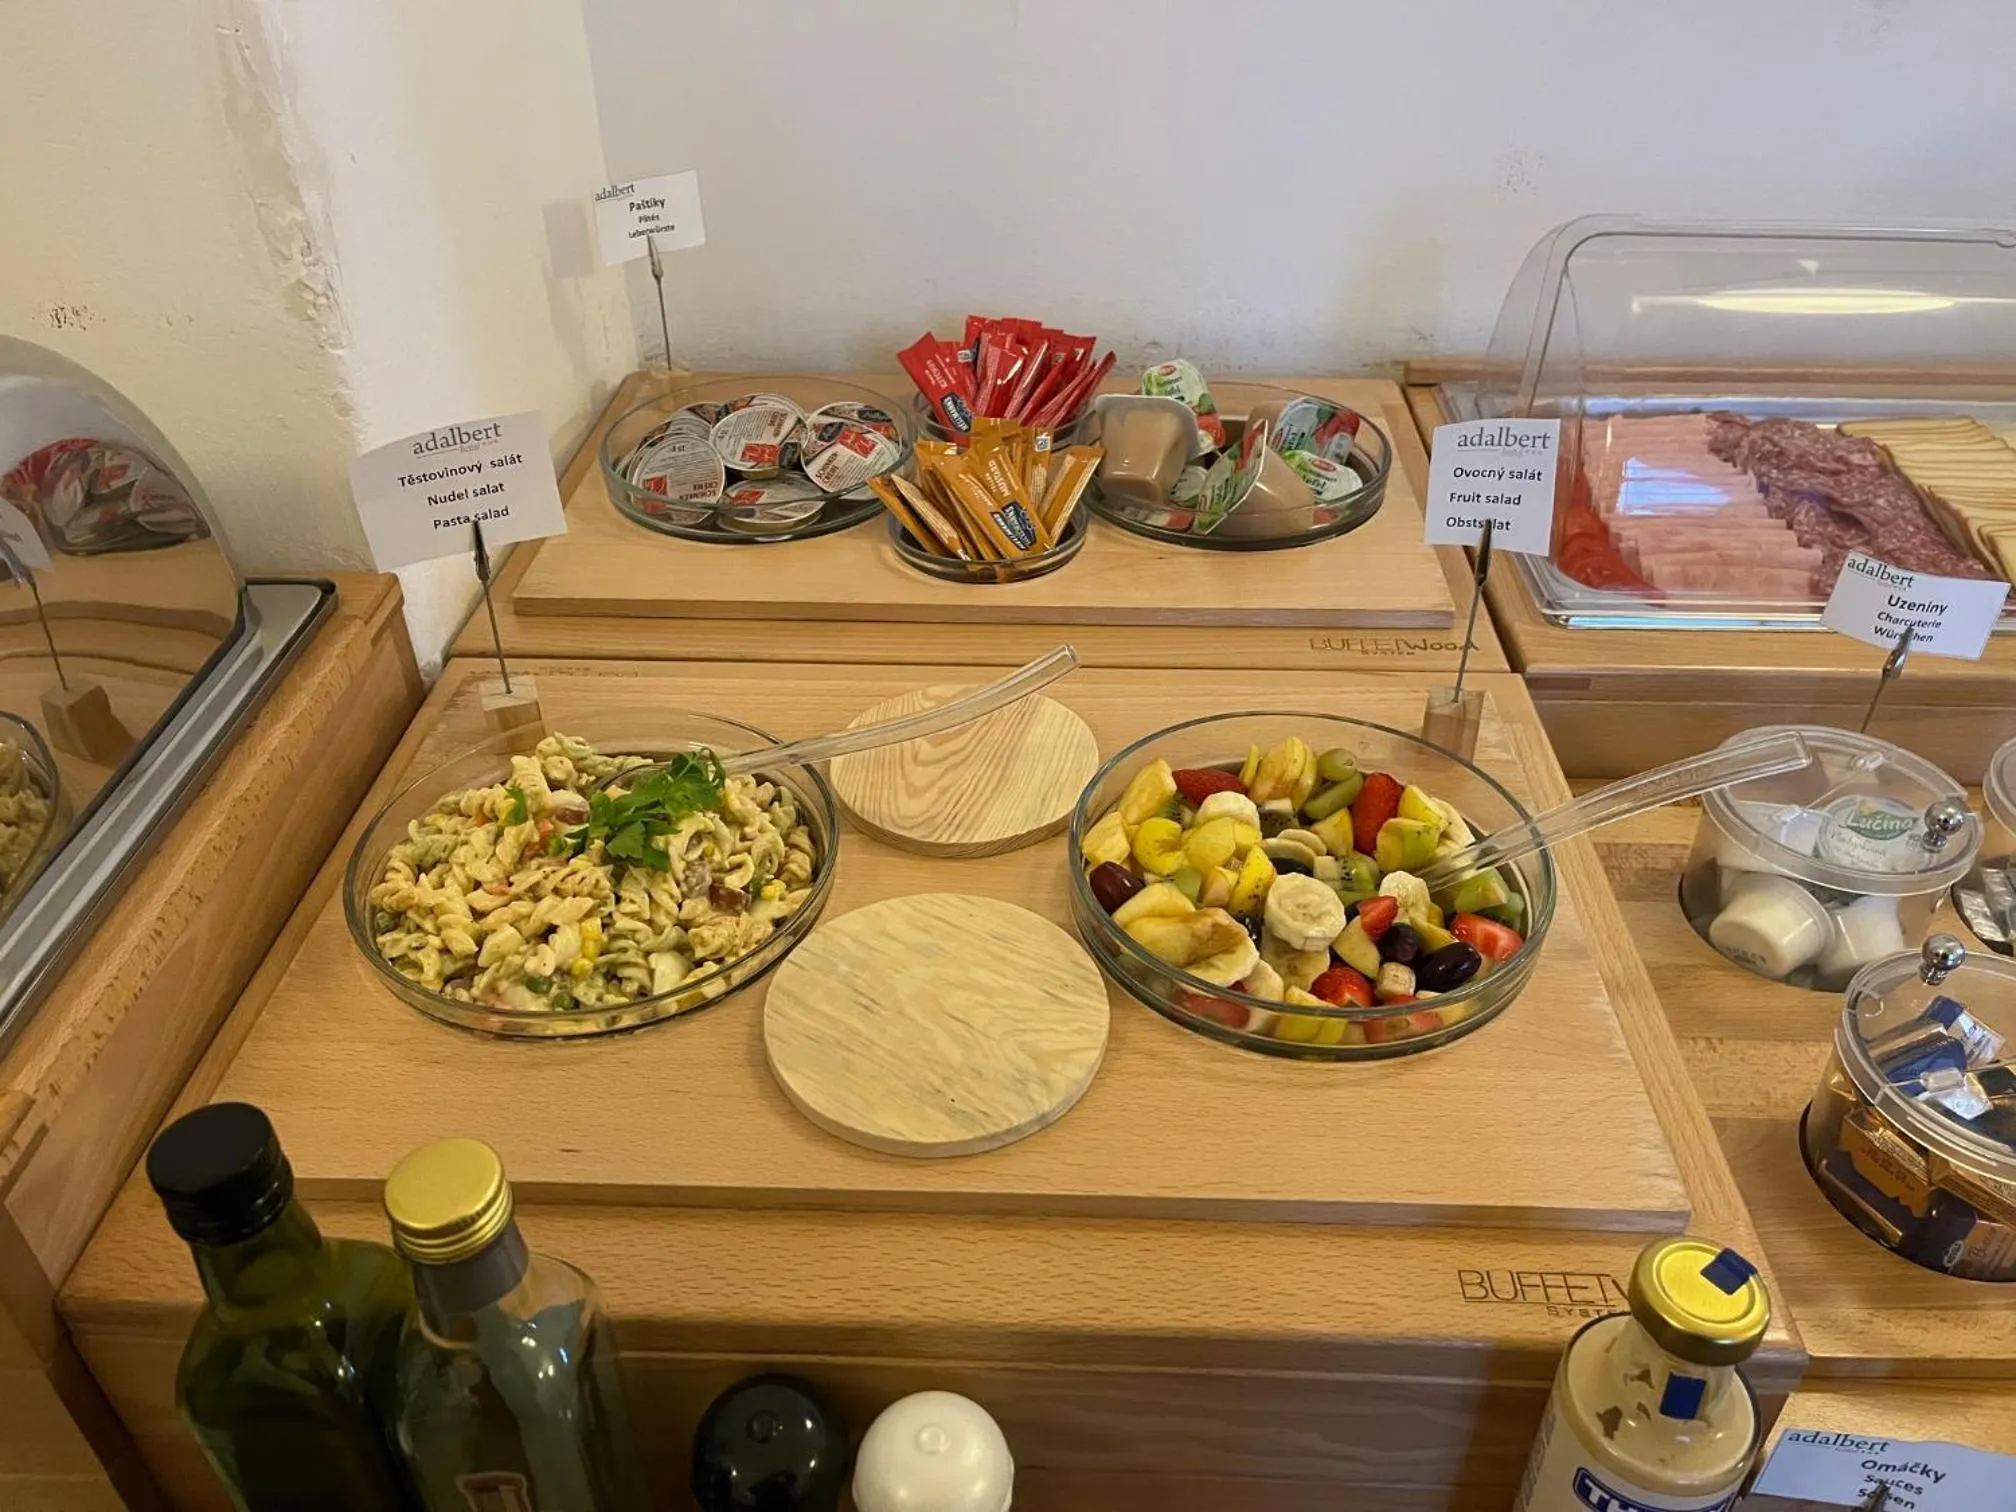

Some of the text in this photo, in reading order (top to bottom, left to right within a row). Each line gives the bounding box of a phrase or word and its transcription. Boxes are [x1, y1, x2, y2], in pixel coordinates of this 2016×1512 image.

[595, 184, 635, 202] adalbert
[629, 198, 665, 212] Paštiky
[412, 422, 502, 455] adalbert
[1457, 426, 1551, 449] adalbert
[398, 453, 523, 488] Těstovinový salát
[1453, 467, 1543, 482] Ovocný salát
[427, 482, 505, 507] Nudel salat
[1449, 492, 1522, 505] Fruit salad
[433, 505, 510, 530] Pasta salad
[1446, 516, 1511, 531] Obstslat
[1847, 557, 1915, 588] adalbert
[1887, 594, 1948, 616] Uzeniny
[1877, 611, 1942, 629] Charcuterie
[1874, 625, 1934, 643] Würhen
[1787, 1432, 1890, 1453] adalbert
[1861, 1459, 1947, 1484] Omáčky
[1864, 1474, 1924, 1495] Sauces
